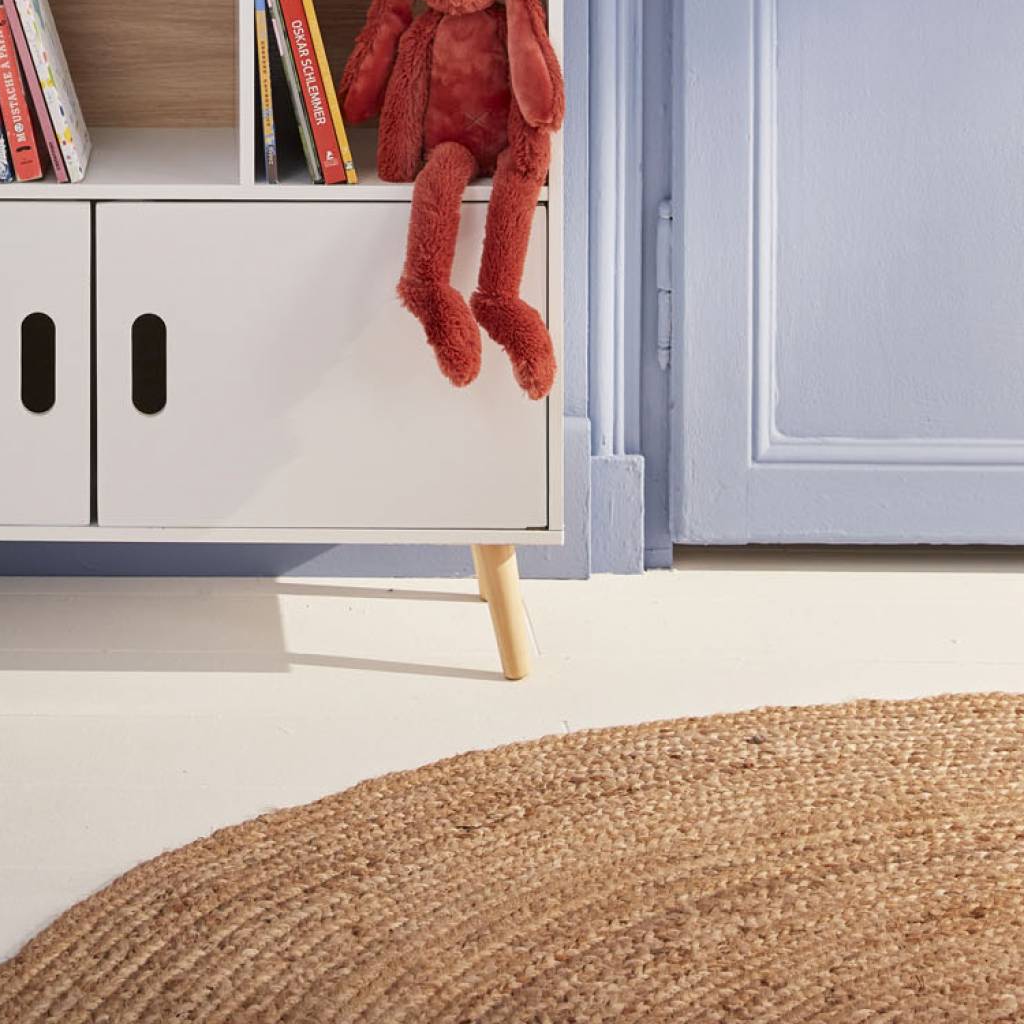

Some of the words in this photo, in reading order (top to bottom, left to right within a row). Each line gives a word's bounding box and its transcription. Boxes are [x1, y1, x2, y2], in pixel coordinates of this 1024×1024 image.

[3, 72, 27, 143] MOUSTACHE
[292, 20, 309, 57] OSKAR
[301, 59, 326, 125] SCHLEMMER
